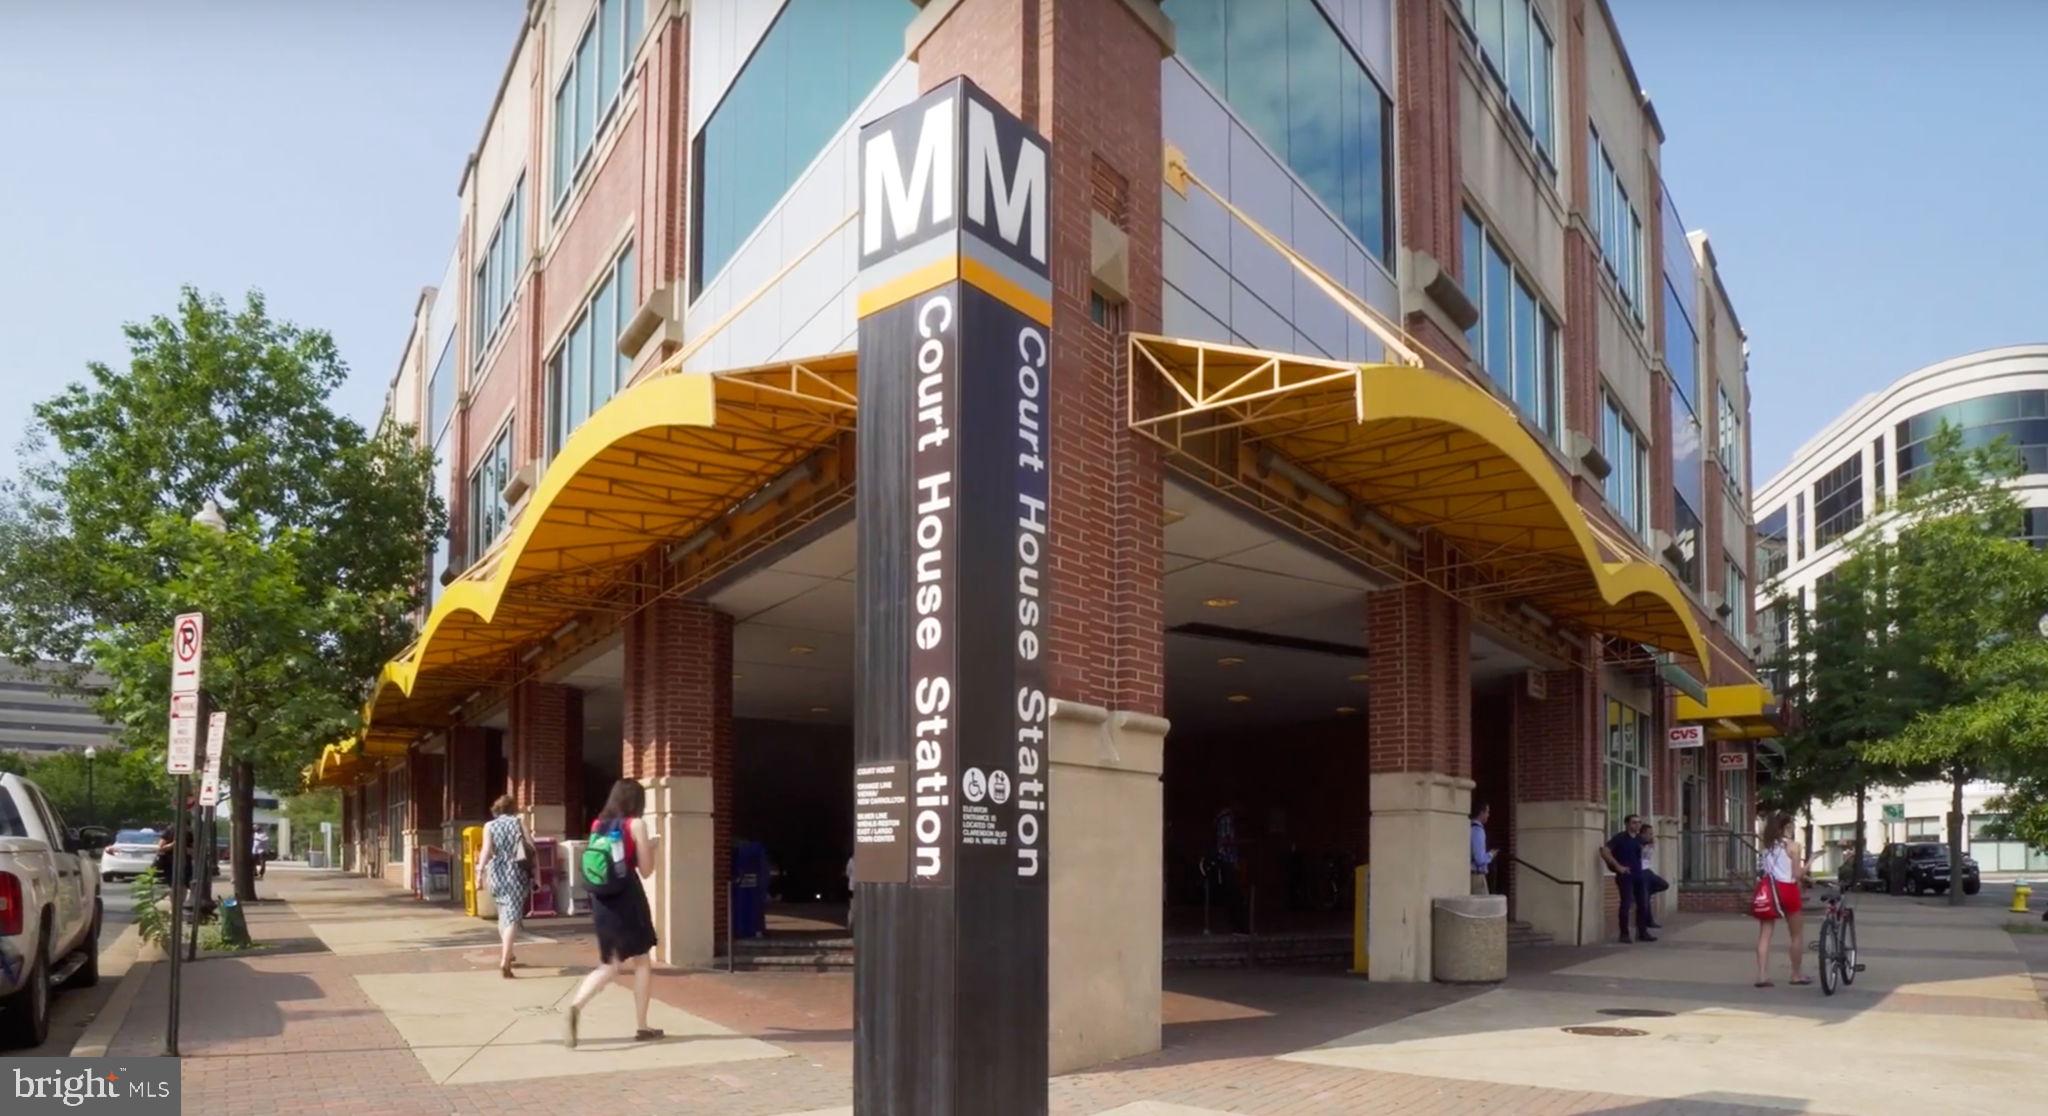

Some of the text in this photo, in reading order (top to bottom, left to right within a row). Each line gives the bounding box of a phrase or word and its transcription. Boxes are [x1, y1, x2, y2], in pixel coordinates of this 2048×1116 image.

[864, 97, 953, 257] M
[967, 97, 1046, 265] M
[915, 295, 951, 876] Court House Station
[1017, 326, 1046, 877] Court House Station
[1670, 728, 1698, 741] CVS
[1720, 754, 1744, 764] CVS
